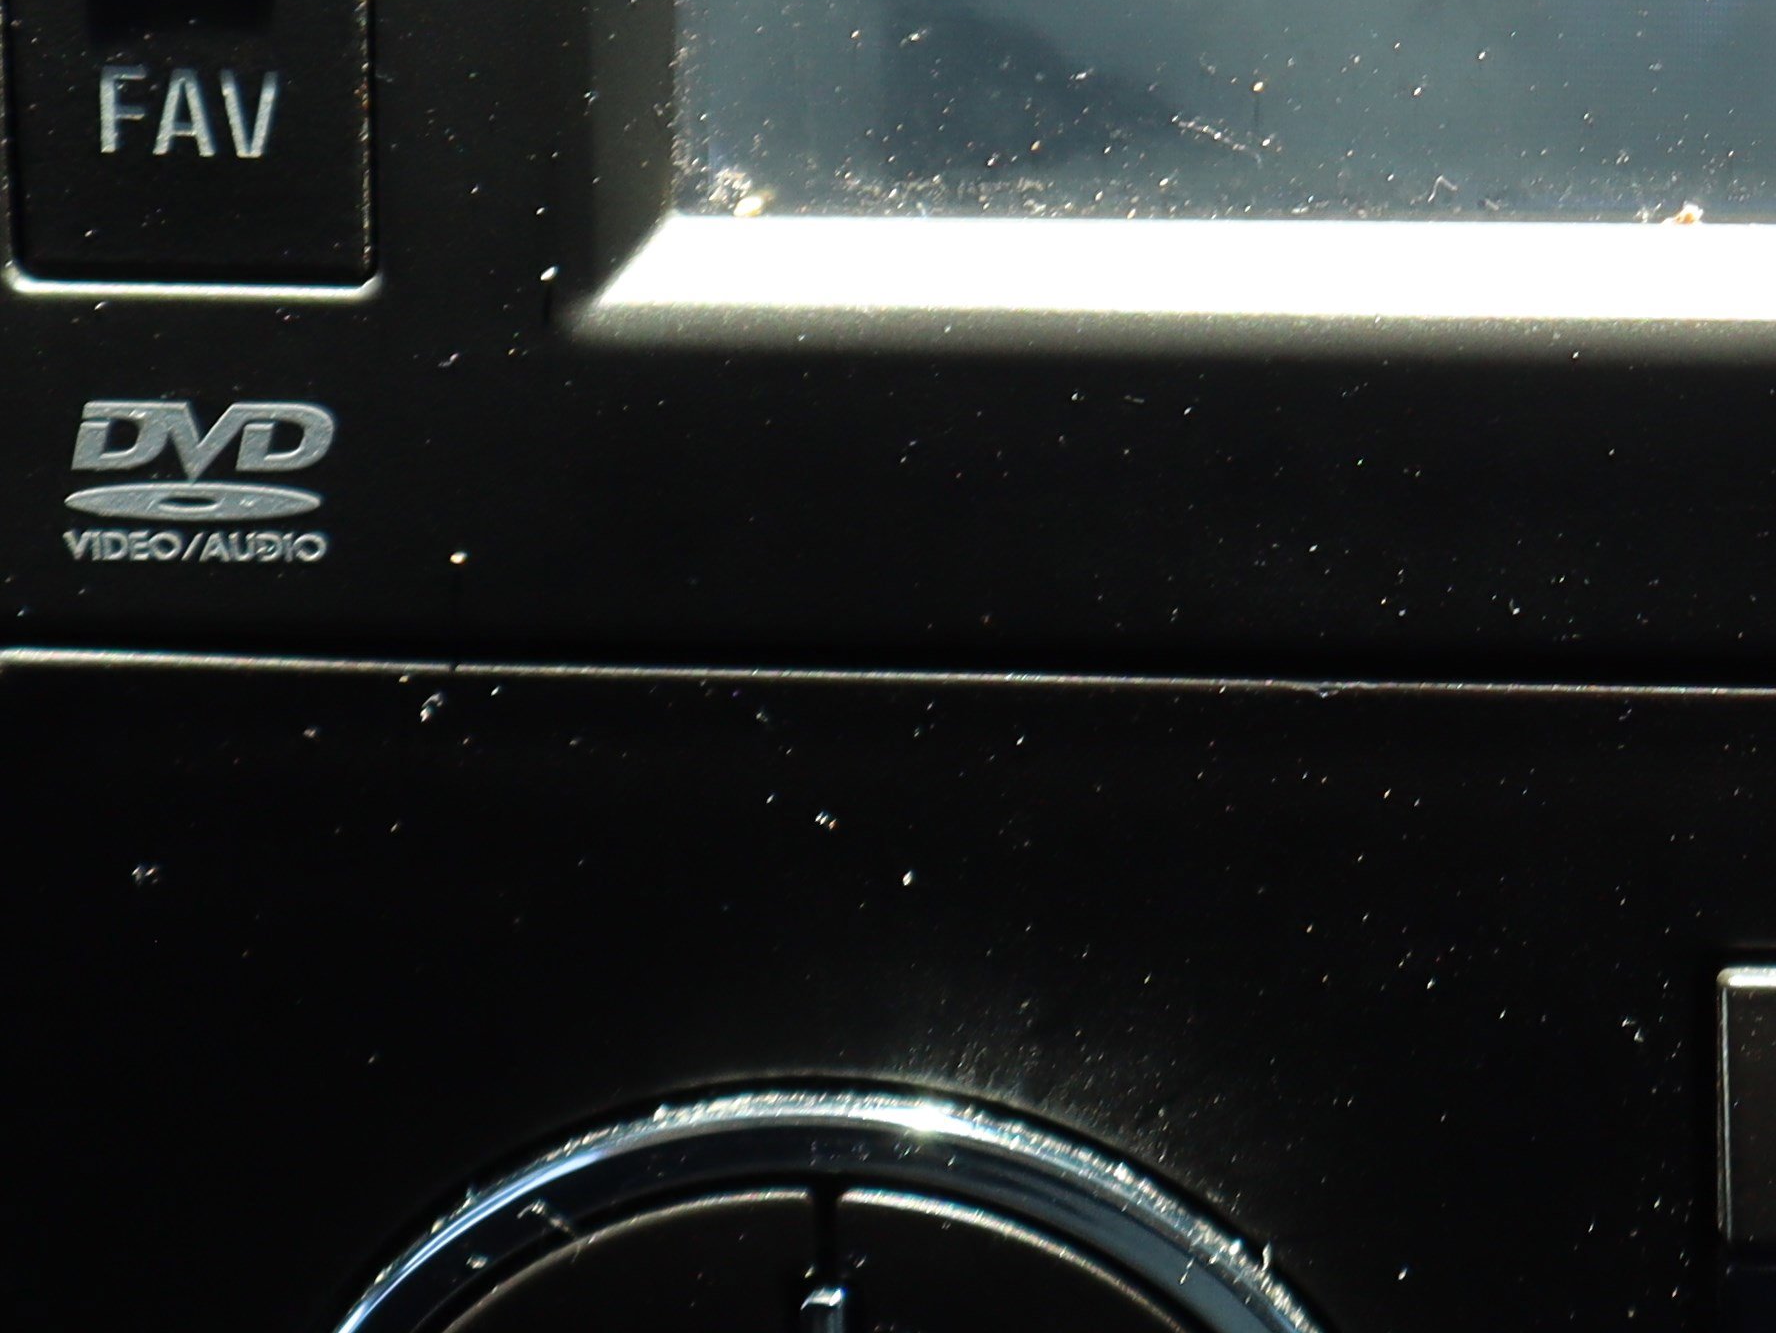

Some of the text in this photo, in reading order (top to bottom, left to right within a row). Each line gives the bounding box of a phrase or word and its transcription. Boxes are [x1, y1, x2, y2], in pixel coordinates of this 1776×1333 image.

[98, 65, 280, 160] FAV
[70, 399, 336, 482] DVD
[62, 527, 329, 563] VIDEO/AUDIO
